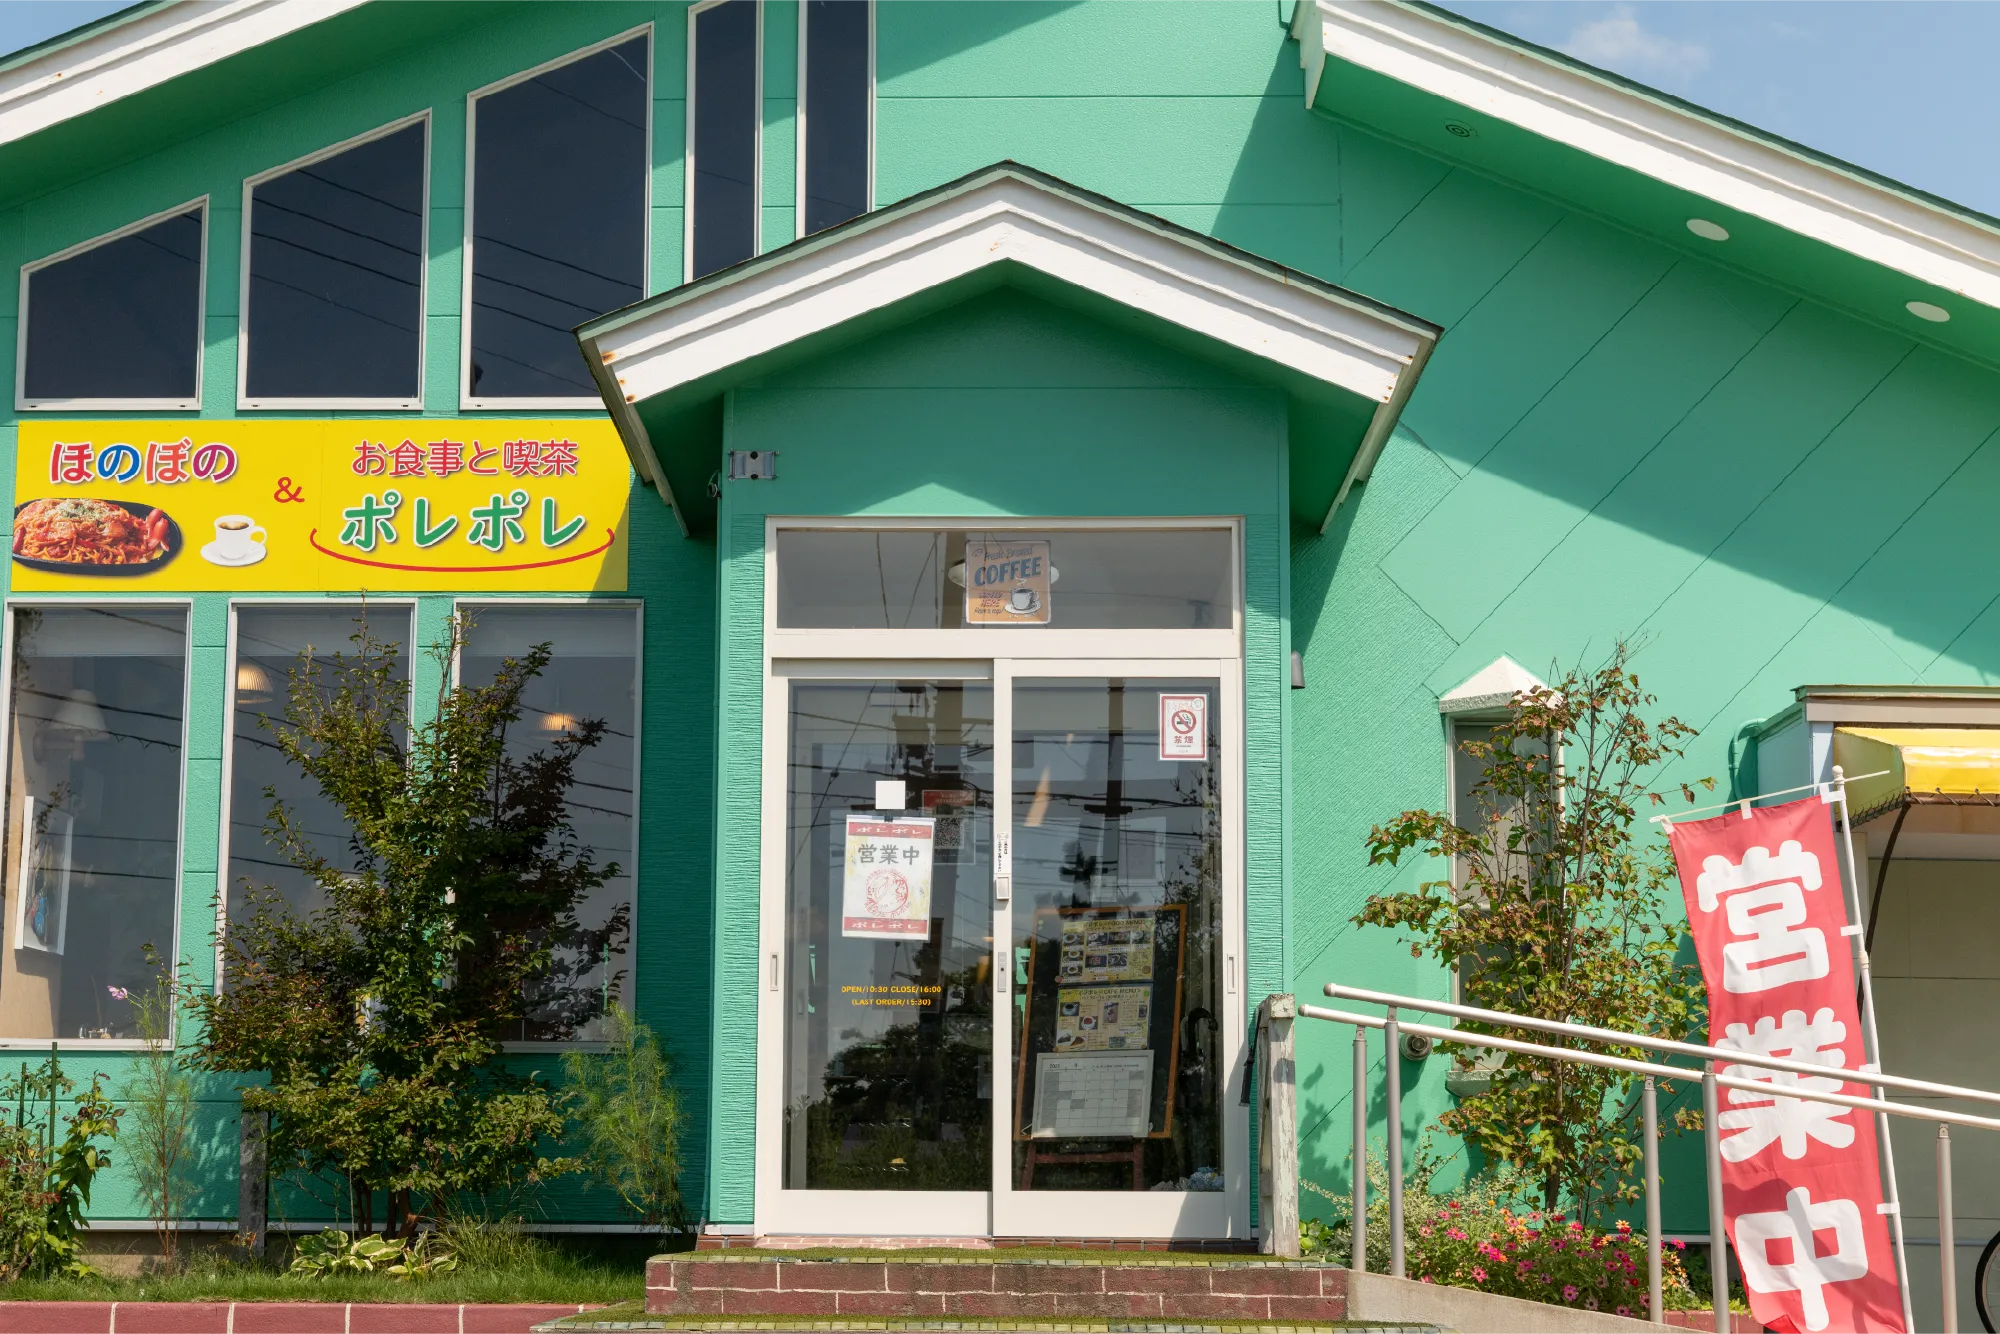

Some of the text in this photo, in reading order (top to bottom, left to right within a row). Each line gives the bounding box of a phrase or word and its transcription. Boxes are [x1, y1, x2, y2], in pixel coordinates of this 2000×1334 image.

[50, 438, 238, 484] ほのぼの
[352, 439, 580, 478] お食事と喫茶
[273, 476, 305, 504] &
[340, 489, 586, 552] ポレポレ
[974, 556, 1042, 587] COFFEE
[1173, 735, 1194, 744] 禁煙
[857, 843, 920, 866] 営業中
[841, 985, 942, 994] OPEN/10:30 CLOSE/16:00
[851, 998, 931, 1007] (LAST ORDER/15:30)
[1696, 839, 1869, 1332] 営業中
